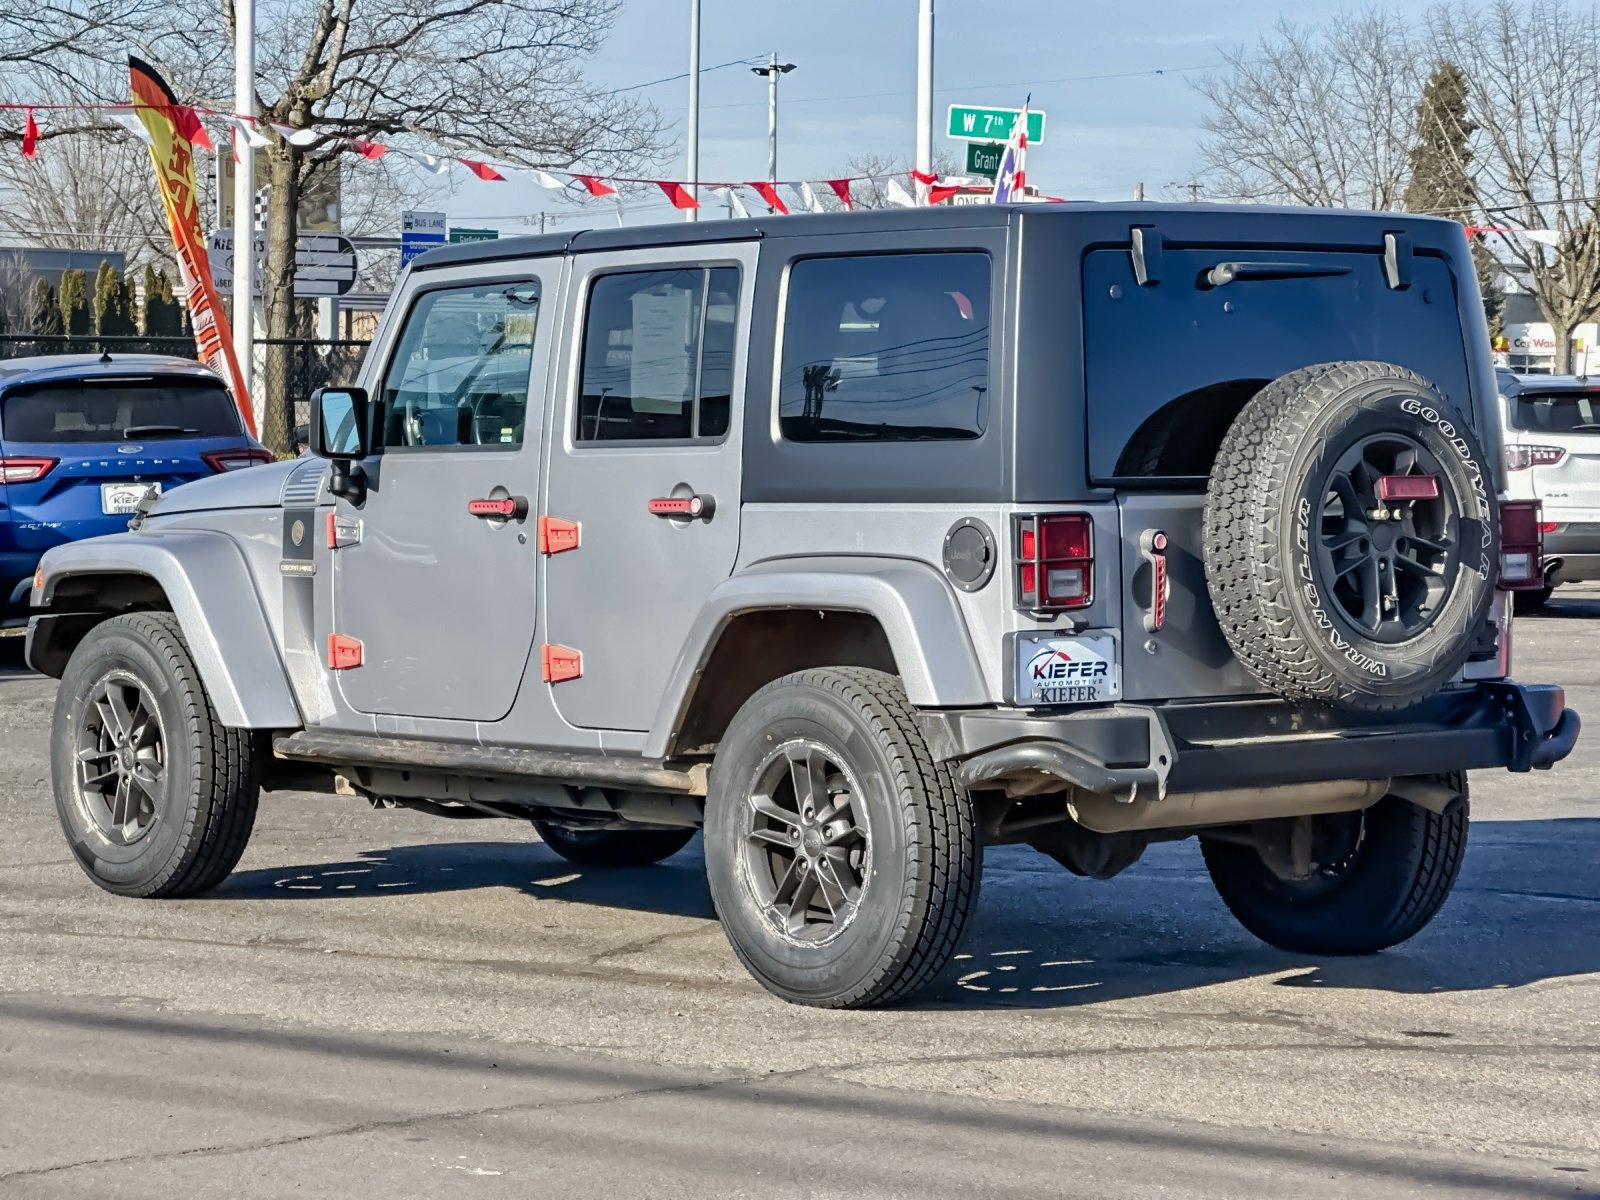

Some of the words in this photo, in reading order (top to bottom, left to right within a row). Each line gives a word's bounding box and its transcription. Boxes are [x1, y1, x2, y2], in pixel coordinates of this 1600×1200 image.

[963, 113, 976, 132] W
[984, 115, 1004, 133] 7th
[974, 150, 999, 170] Grant
[414, 218, 427, 228] BUS
[429, 219, 444, 228] LANE
[214, 278, 233, 288] USED
[1533, 338, 1554, 348] Was
[1400, 398, 1493, 581] GOODYEAR
[1296, 498, 1387, 677] WRANGLER
[1033, 659, 1108, 680] KIEFER
[1036, 679, 1103, 688] AUTOMOTIVE
[1040, 686, 1097, 703] KIEFER
